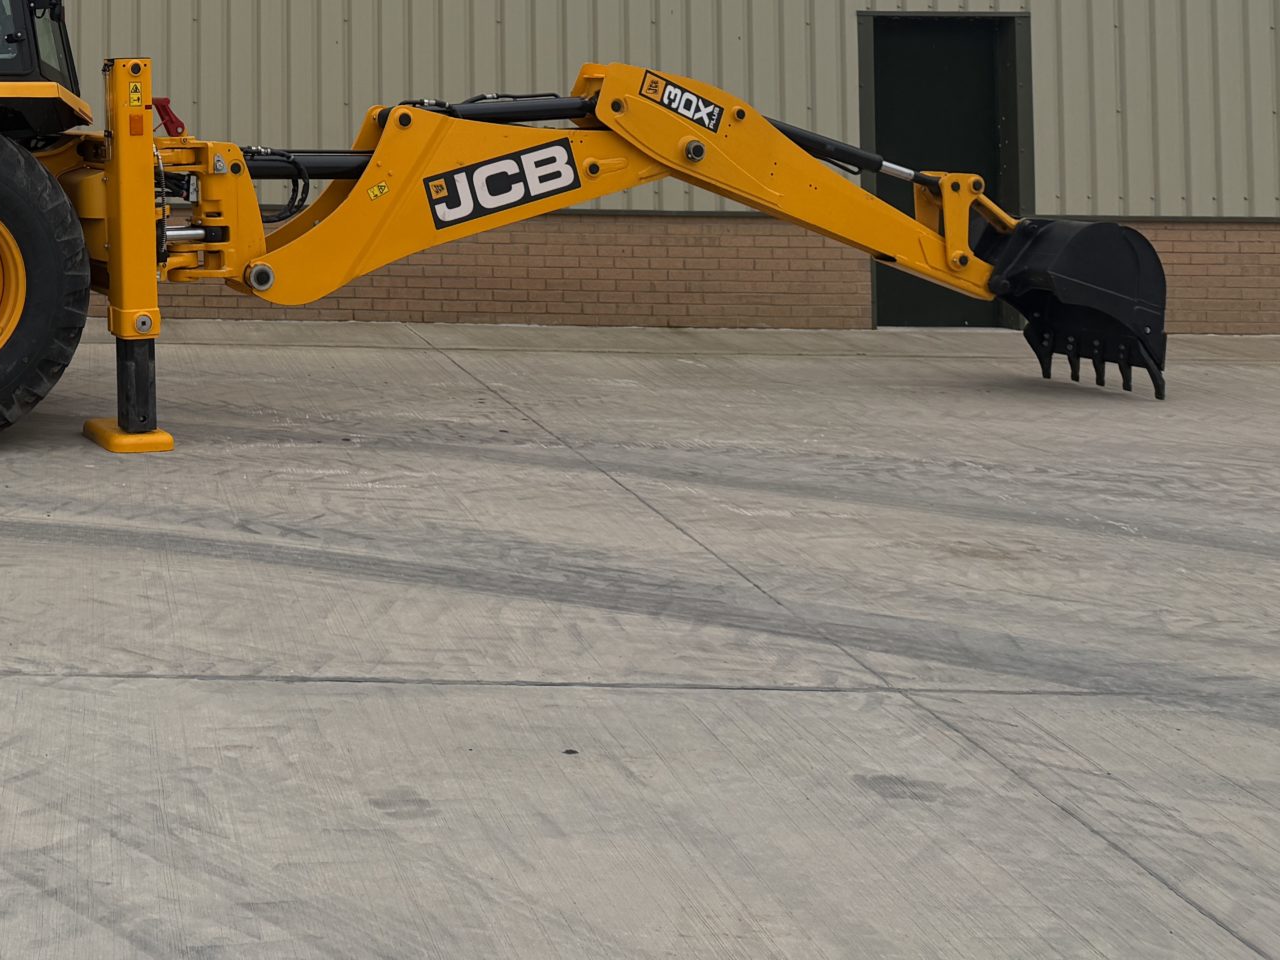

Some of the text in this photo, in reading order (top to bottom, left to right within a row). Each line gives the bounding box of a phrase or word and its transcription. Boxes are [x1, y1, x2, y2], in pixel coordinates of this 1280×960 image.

[663, 84, 715, 128] 3DX
[708, 106, 720, 129] PLUS
[434, 145, 575, 222] JCB
